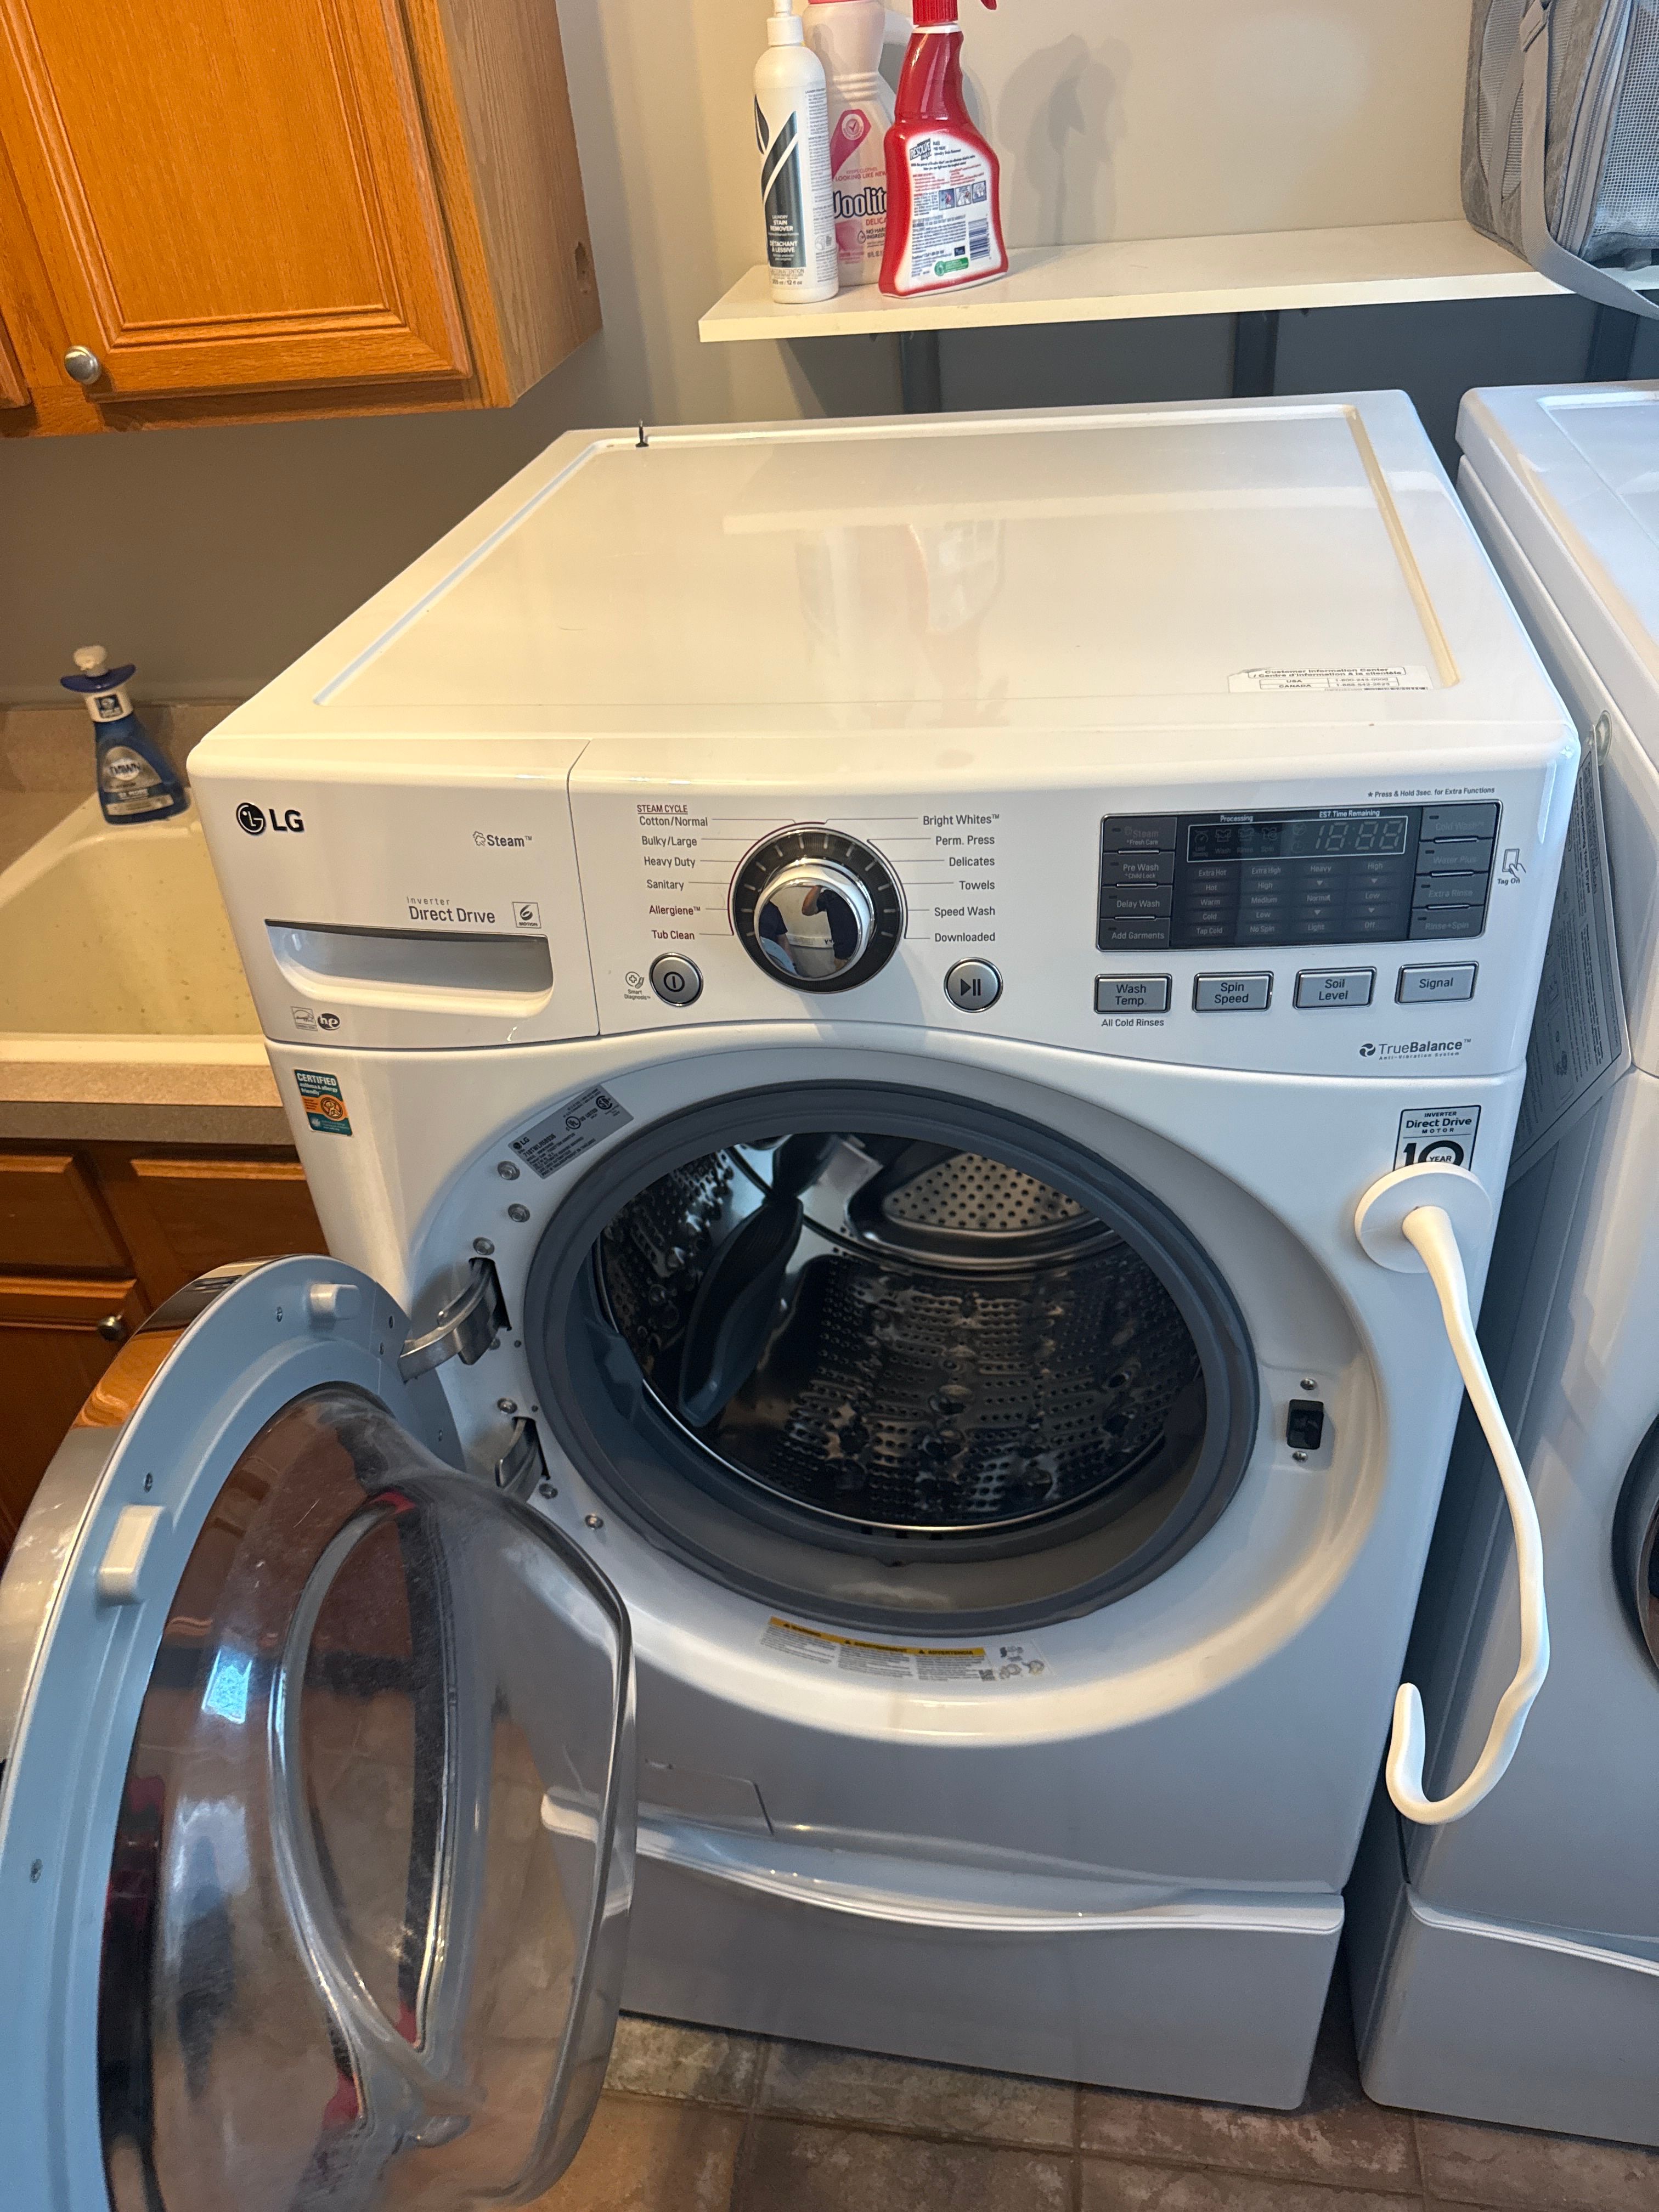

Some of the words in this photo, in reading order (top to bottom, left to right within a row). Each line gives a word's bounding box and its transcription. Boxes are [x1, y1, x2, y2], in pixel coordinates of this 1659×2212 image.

[910, 141, 930, 160] RESOLVE
[833, 187, 887, 219] oolit
[637, 804, 663, 813] STEAM
[664, 805, 689, 813] CYCLE
[269, 808, 305, 834] LG
[639, 816, 708, 827] Cotton/Normal
[923, 815, 953, 827] Bright
[641, 836, 697, 848] Bulky/Large
[935, 836, 964, 846] Perm.
[967, 835, 995, 845] Press
[644, 856, 672, 868] Heavy
[674, 857, 696, 868] Duty
[949, 857, 995, 867] Delicates
[1310, 865, 1331, 873] Heavy
[646, 879, 684, 891] Sanitary
[959, 880, 995, 890] Towels
[1258, 882, 1273, 890] High
[407, 896, 450, 906] Inverter
[1116, 900, 1137, 909] Delay
[409, 906, 454, 922] Direct
[456, 907, 496, 924] Drive
[934, 907, 965, 918] Speed
[967, 906, 995, 916] Wash
[1260, 925, 1275, 933] Spin
[1307, 924, 1325, 932] Light
[651, 930, 668, 940] Tub
[670, 930, 695, 940] Clean
[934, 932, 996, 943] Downloaded
[1128, 931, 1165, 940] Garments
[1115, 983, 1147, 995] Wash
[1220, 981, 1245, 994] Spin
[1324, 979, 1346, 990] Soil
[1419, 977, 1454, 990] Signal
[1214, 992, 1249, 1006] Speed
[1318, 989, 1348, 1001] Level
[1115, 995, 1147, 1007] Temp.
[1101, 1018, 1113, 1027] All
[1115, 1018, 1134, 1027] Cold
[1136, 1018, 1164, 1027] Rinses
[297, 1073, 337, 1086] CERTIFIED
[1406, 1119, 1440, 1128] Direct
[1442, 1117, 1472, 1126] Drive
[520, 1137, 530, 1146] LG
[1403, 1140, 1464, 1167] 10
